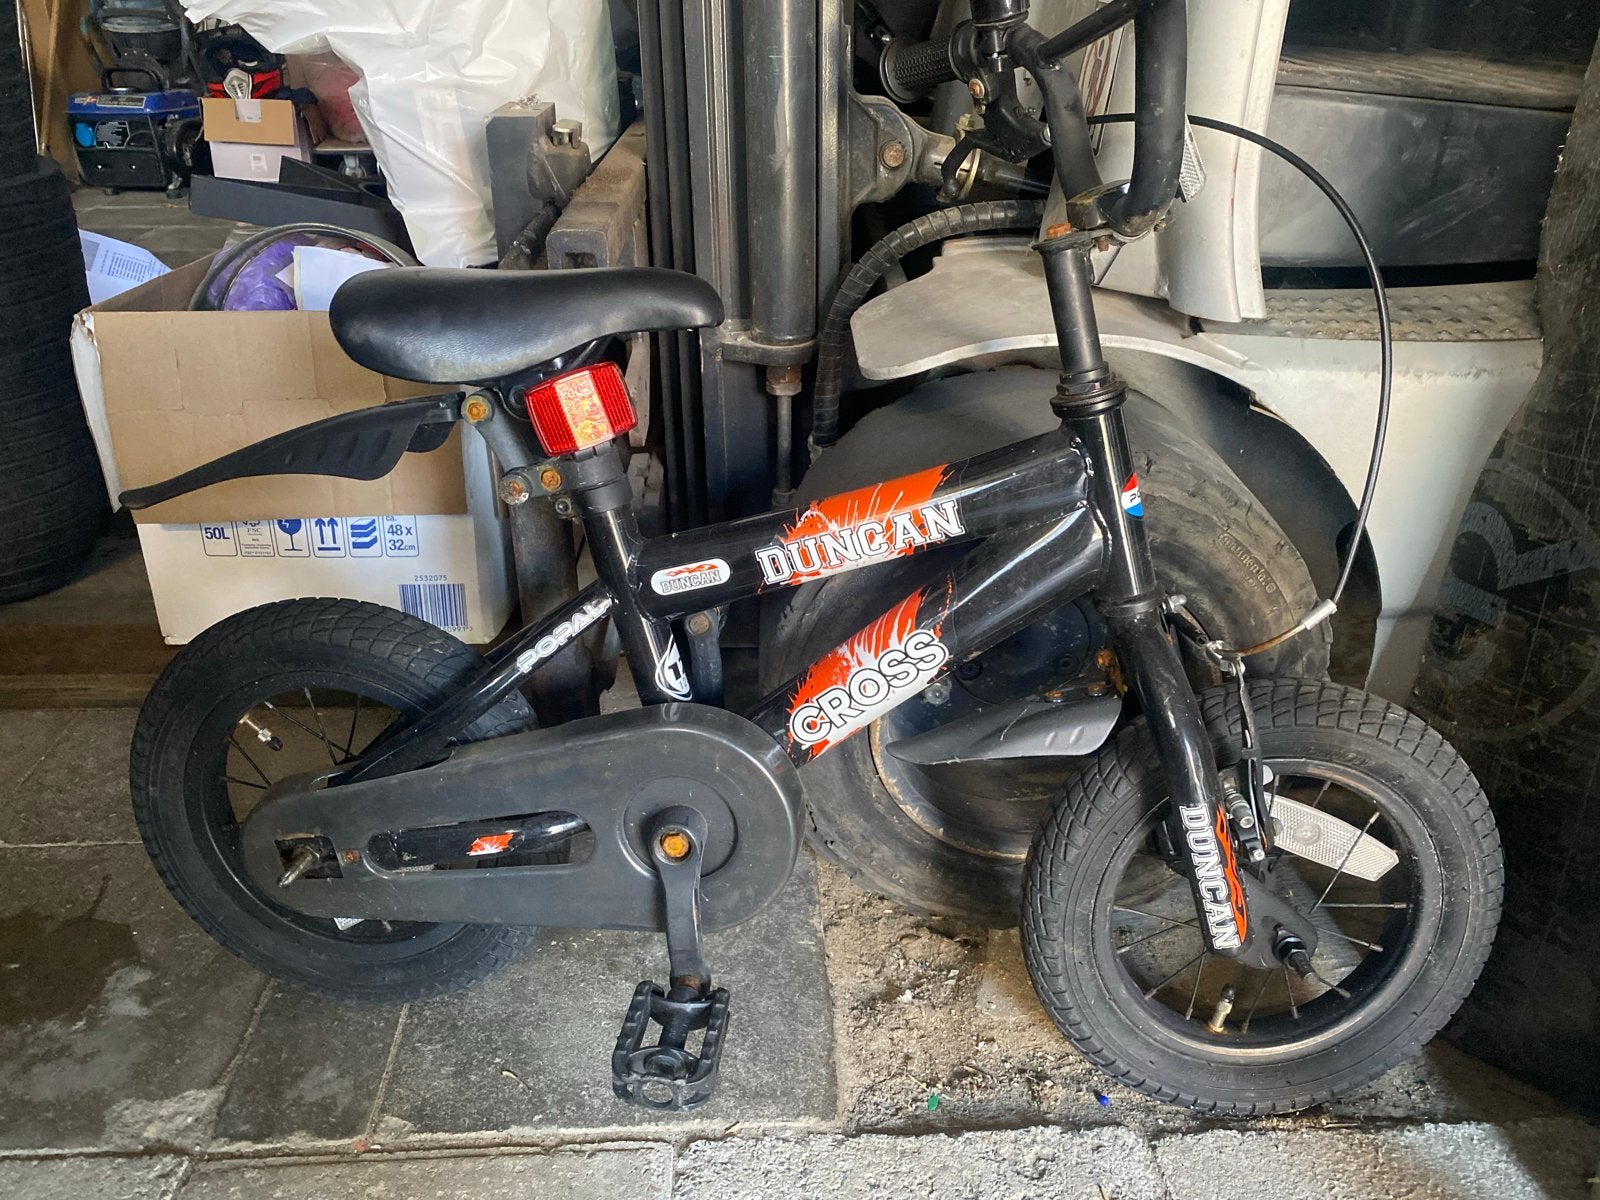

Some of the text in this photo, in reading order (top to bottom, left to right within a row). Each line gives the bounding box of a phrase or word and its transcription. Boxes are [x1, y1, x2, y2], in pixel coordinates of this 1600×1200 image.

[204, 527, 230, 540] 50L
[387, 524, 413, 536] 48 x
[754, 499, 966, 585] DUNCAN
[388, 539, 416, 551] 32cm
[413, 574, 448, 582] 2532075
[660, 569, 722, 594] DUNCAN
[516, 597, 613, 674] POPAL
[790, 629, 949, 744] CROSS
[1179, 803, 1242, 950] DUNCAN
